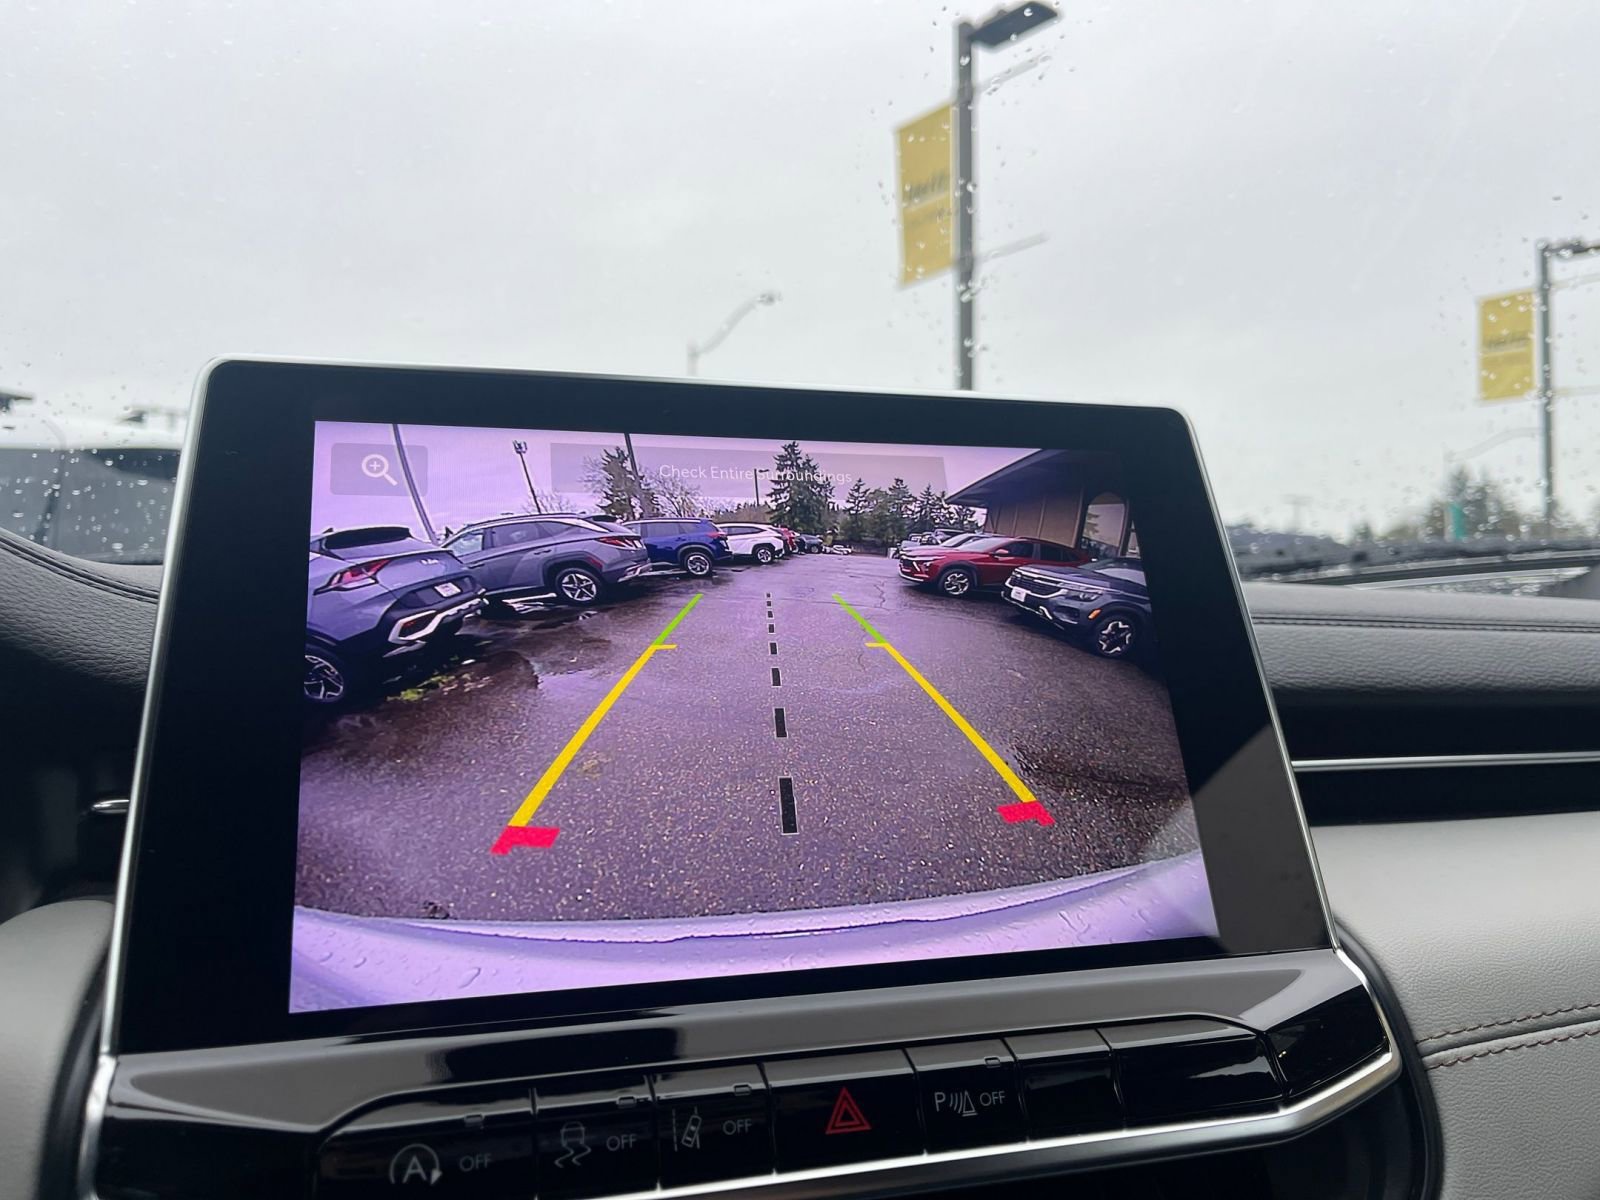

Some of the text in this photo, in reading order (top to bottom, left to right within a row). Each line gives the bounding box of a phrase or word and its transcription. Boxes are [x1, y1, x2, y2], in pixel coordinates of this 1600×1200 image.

[659, 464, 852, 484] Check Entire Surroundings
[934, 1090, 1005, 1112] P OFF
[723, 1118, 753, 1136] OFF
[606, 1133, 637, 1151] OFF
[402, 1152, 492, 1184] A OFF
